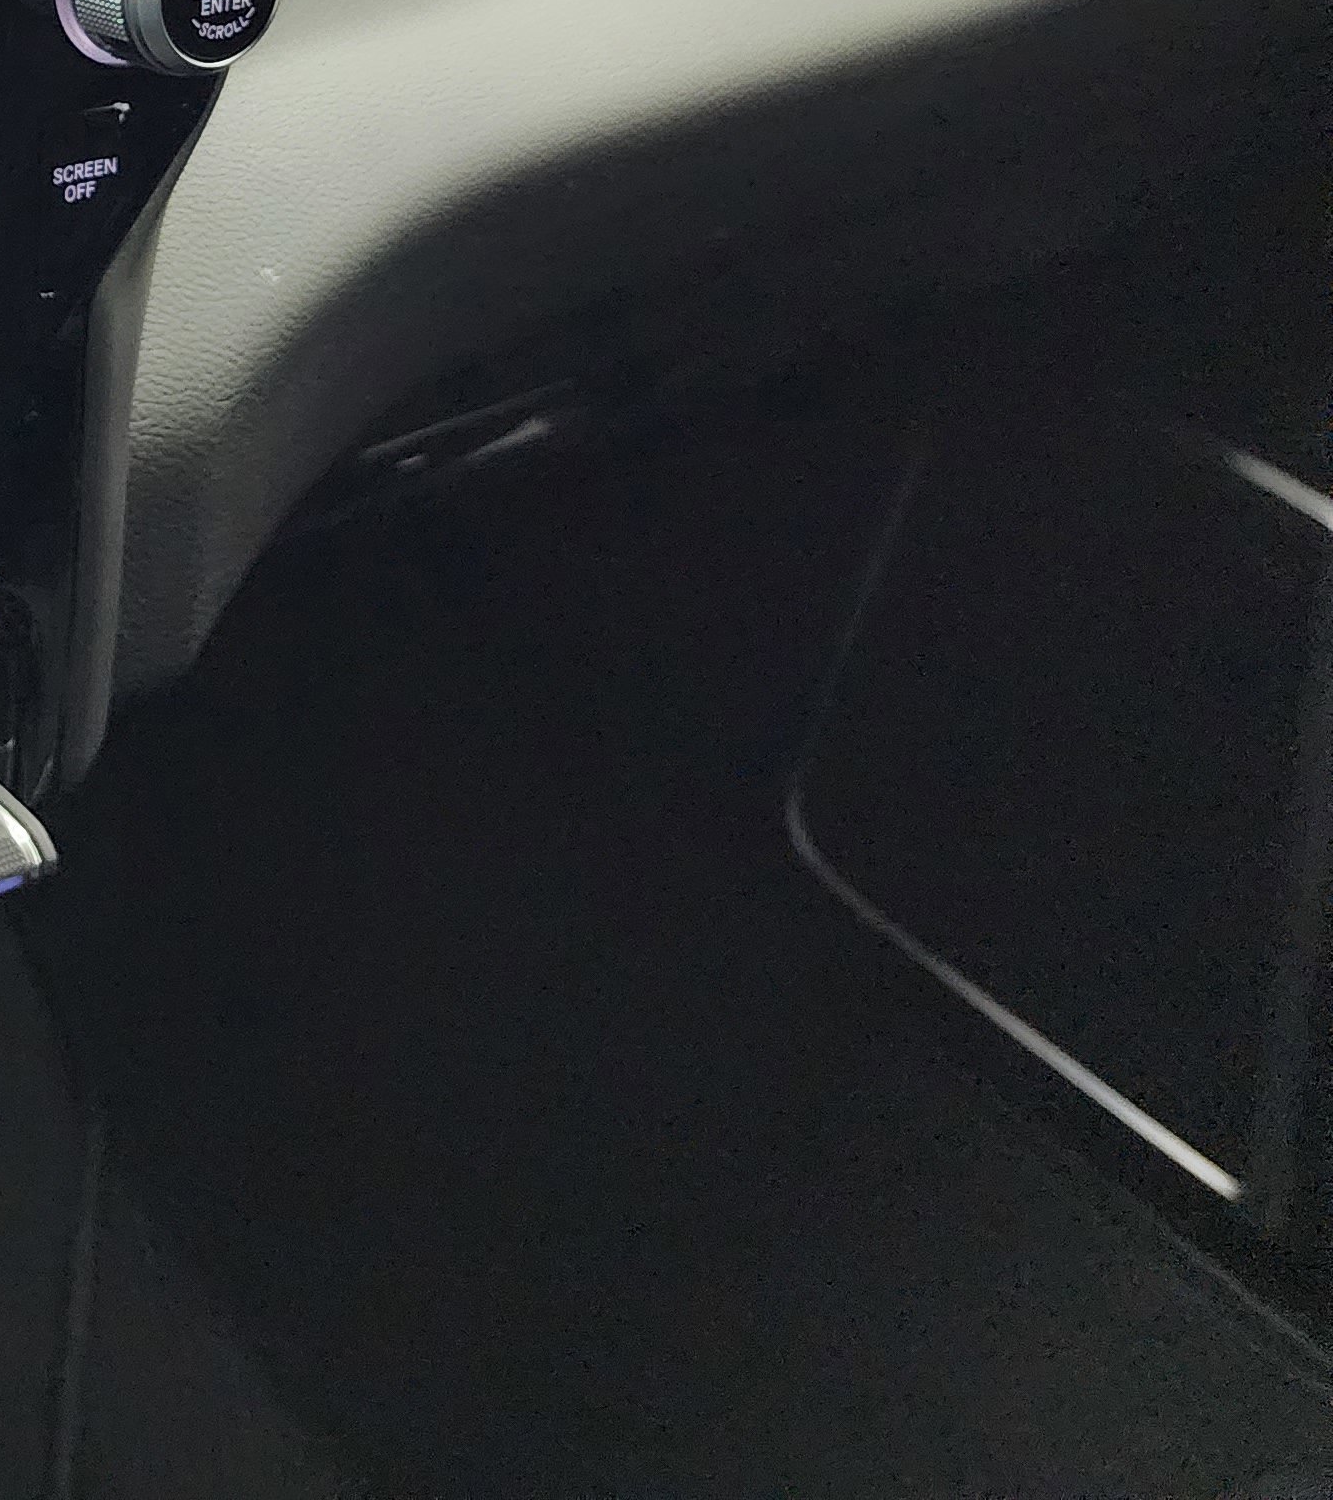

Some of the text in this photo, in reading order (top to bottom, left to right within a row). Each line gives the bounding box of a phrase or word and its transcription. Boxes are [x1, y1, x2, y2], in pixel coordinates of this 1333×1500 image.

[199, 16, 250, 40] SCROLL
[52, 156, 118, 186] SCREEN
[64, 180, 97, 203] OFF
